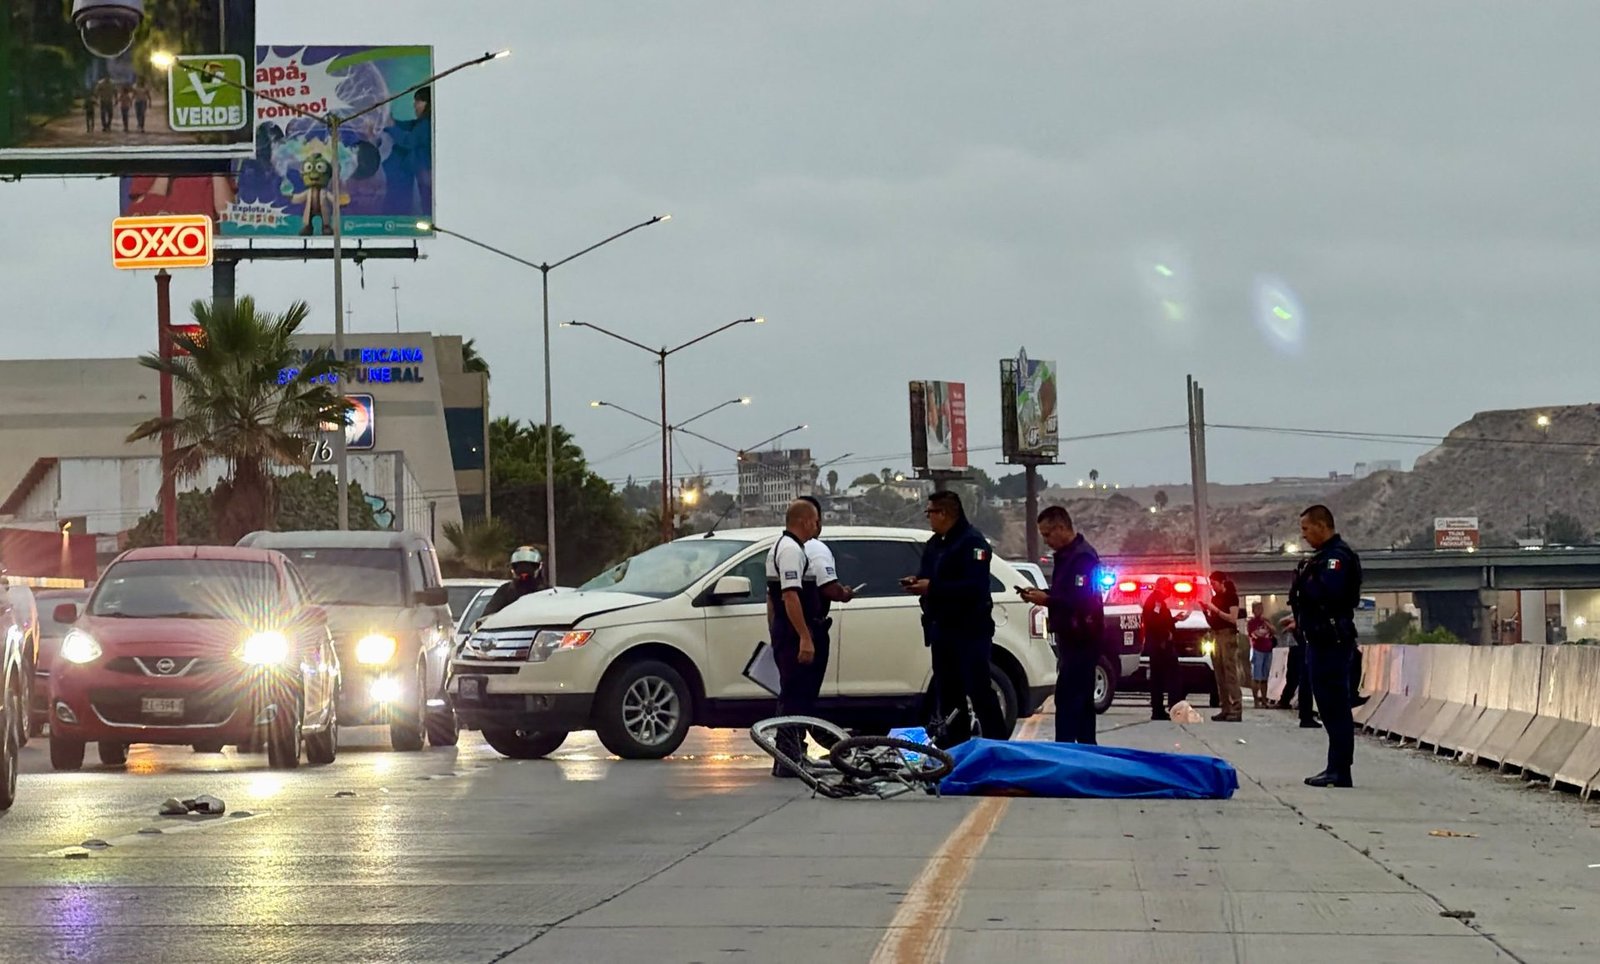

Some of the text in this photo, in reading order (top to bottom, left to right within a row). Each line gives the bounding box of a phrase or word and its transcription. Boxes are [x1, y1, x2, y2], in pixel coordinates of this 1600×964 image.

[256, 85, 311, 98] ame a
[176, 105, 240, 126] VERDE
[257, 98, 327, 119] rompo!
[232, 204, 265, 214] Explota
[115, 224, 205, 259] OXXO
